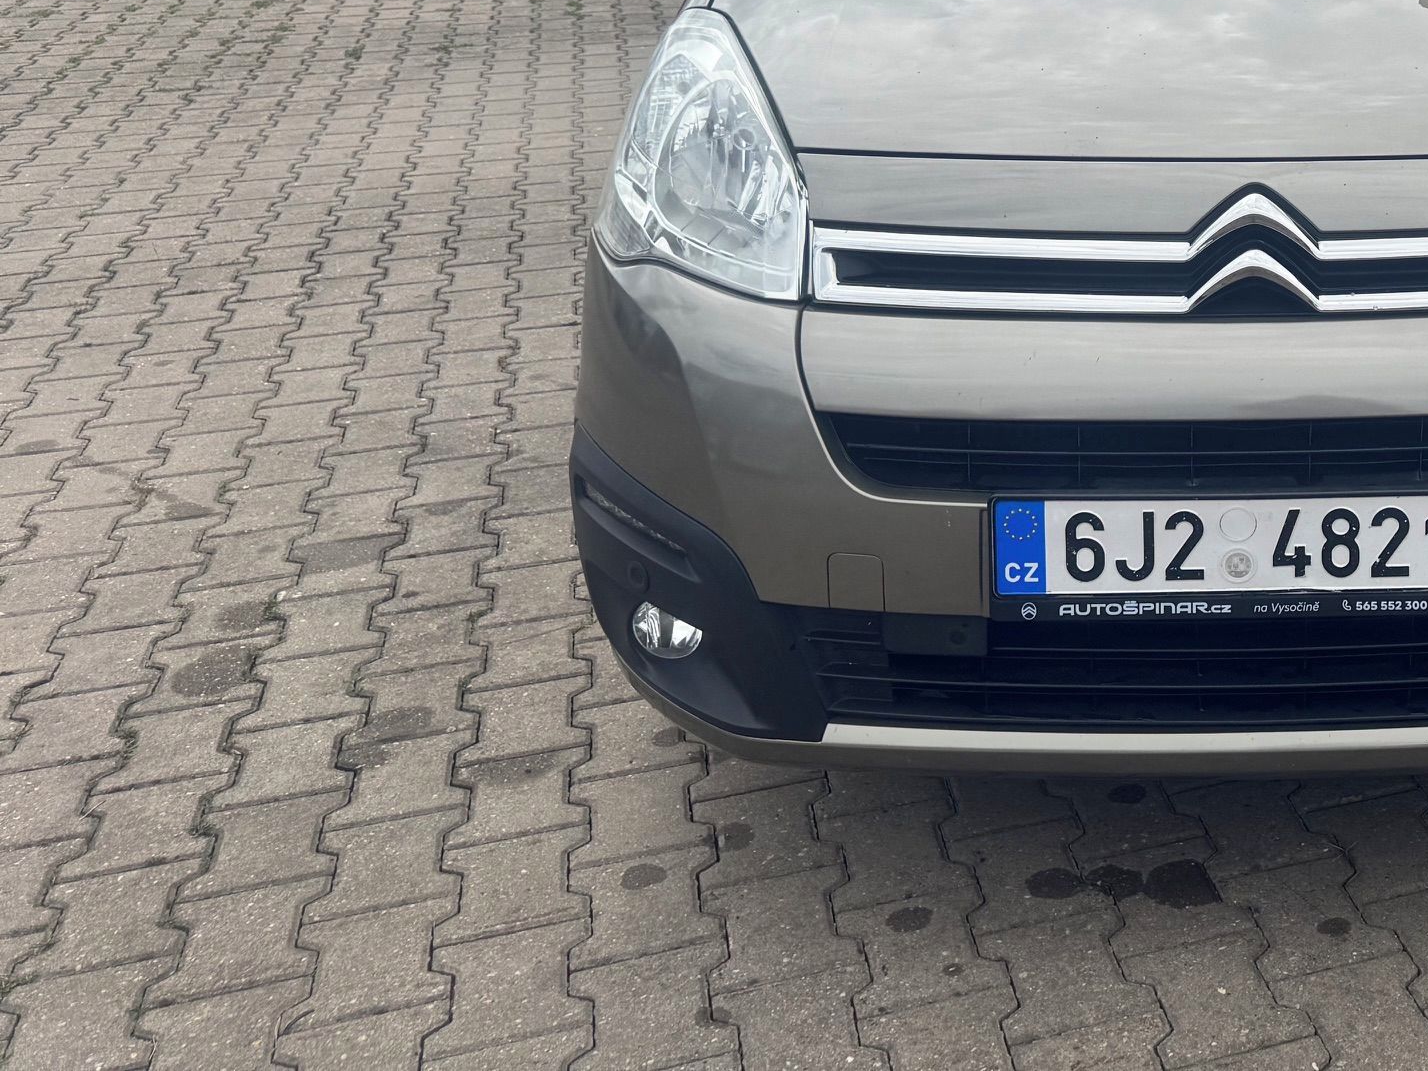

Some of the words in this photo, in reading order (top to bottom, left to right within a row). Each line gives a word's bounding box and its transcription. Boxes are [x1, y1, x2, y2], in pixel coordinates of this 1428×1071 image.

[1065, 511, 1205, 582] 6J2
[1004, 562, 1039, 583] CZ
[1253, 605, 1268, 613] na
[1271, 601, 1321, 615] Vysočině
[1355, 601, 1378, 611] 565
[1380, 601, 1403, 611] 552
[1405, 600, 1428, 611] 300
